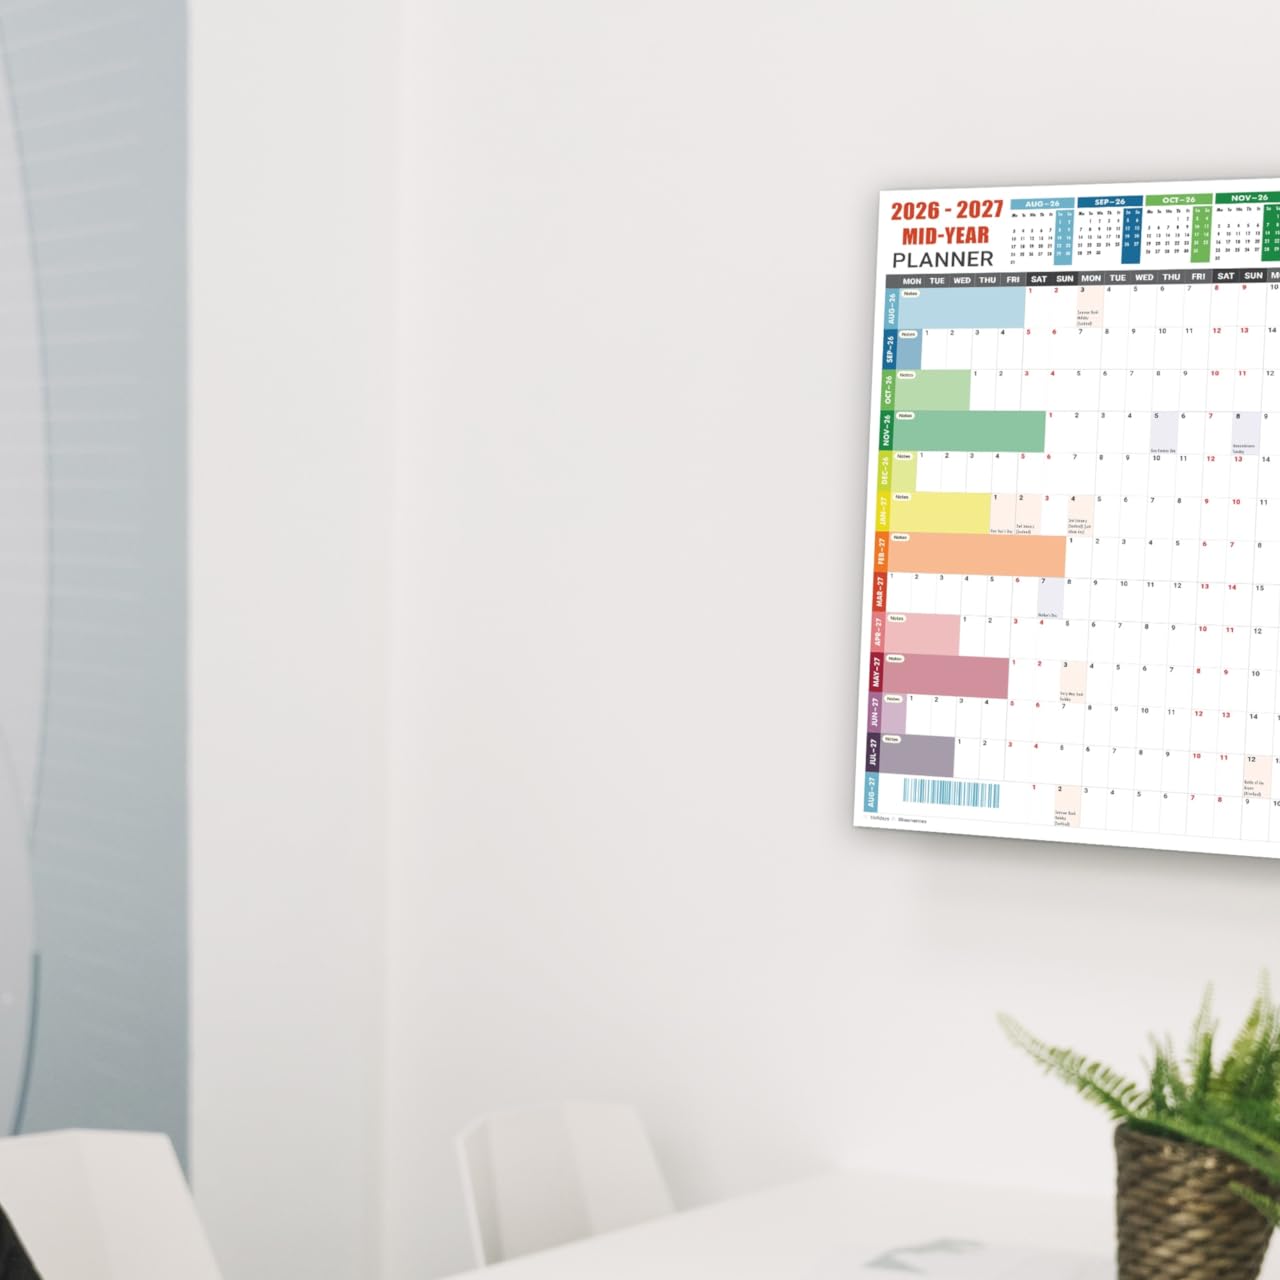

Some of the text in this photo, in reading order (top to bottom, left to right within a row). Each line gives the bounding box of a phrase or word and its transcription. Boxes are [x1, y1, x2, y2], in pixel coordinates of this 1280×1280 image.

[1094, 198, 1126, 206] SEP-26
[1162, 196, 1196, 204] OCT-26
[1231, 194, 1269, 202] NOV-26
[1025, 200, 1060, 208] AUG-26
[891, 202, 940, 221] 2026
[957, 200, 1004, 219] 2027
[902, 226, 989, 245] MID-YEAR
[893, 251, 994, 268] PLANNER
[902, 277, 922, 285] MON
[929, 277, 945, 285] TUE
[953, 276, 972, 285] WED
[979, 276, 997, 284] THU
[1006, 275, 1020, 284] FRI
[1031, 275, 1048, 283] SAT
[1056, 275, 1074, 283] SUN
[1081, 274, 1102, 283] MON
[1109, 273, 1127, 282] TUE
[1135, 273, 1154, 281] WED
[1162, 273, 1181, 281] THU
[1191, 272, 1206, 281] FRI
[1217, 272, 1235, 280] SAT
[1244, 271, 1264, 280] SUN
